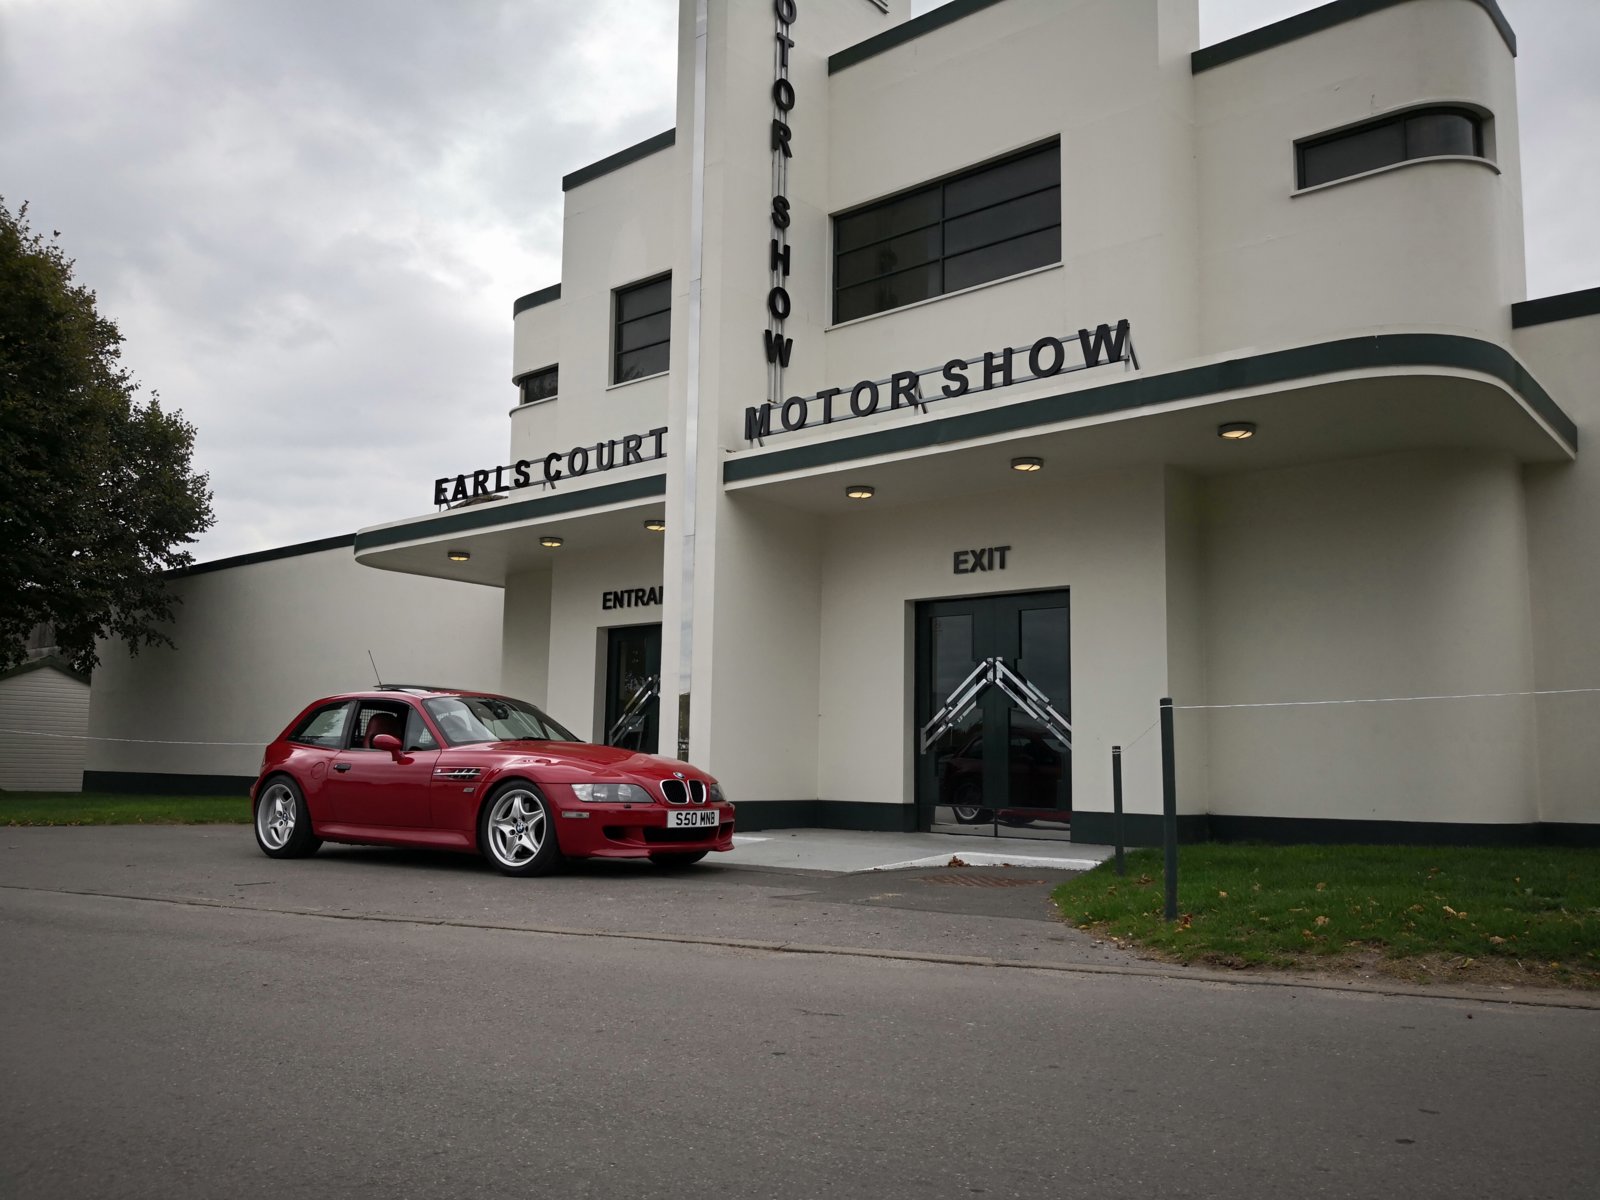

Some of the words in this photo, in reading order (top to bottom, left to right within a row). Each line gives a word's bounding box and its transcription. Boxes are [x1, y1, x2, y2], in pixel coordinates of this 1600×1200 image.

[764, 195, 794, 368] SHOW
[744, 370, 920, 440] MOTOR
[941, 318, 1130, 398] SHOW
[434, 459, 531, 506] EARLS
[543, 426, 668, 481] COURT
[953, 545, 1012, 574] EXIT
[675, 812, 698, 826] S50
[699, 811, 716, 826] MNB
